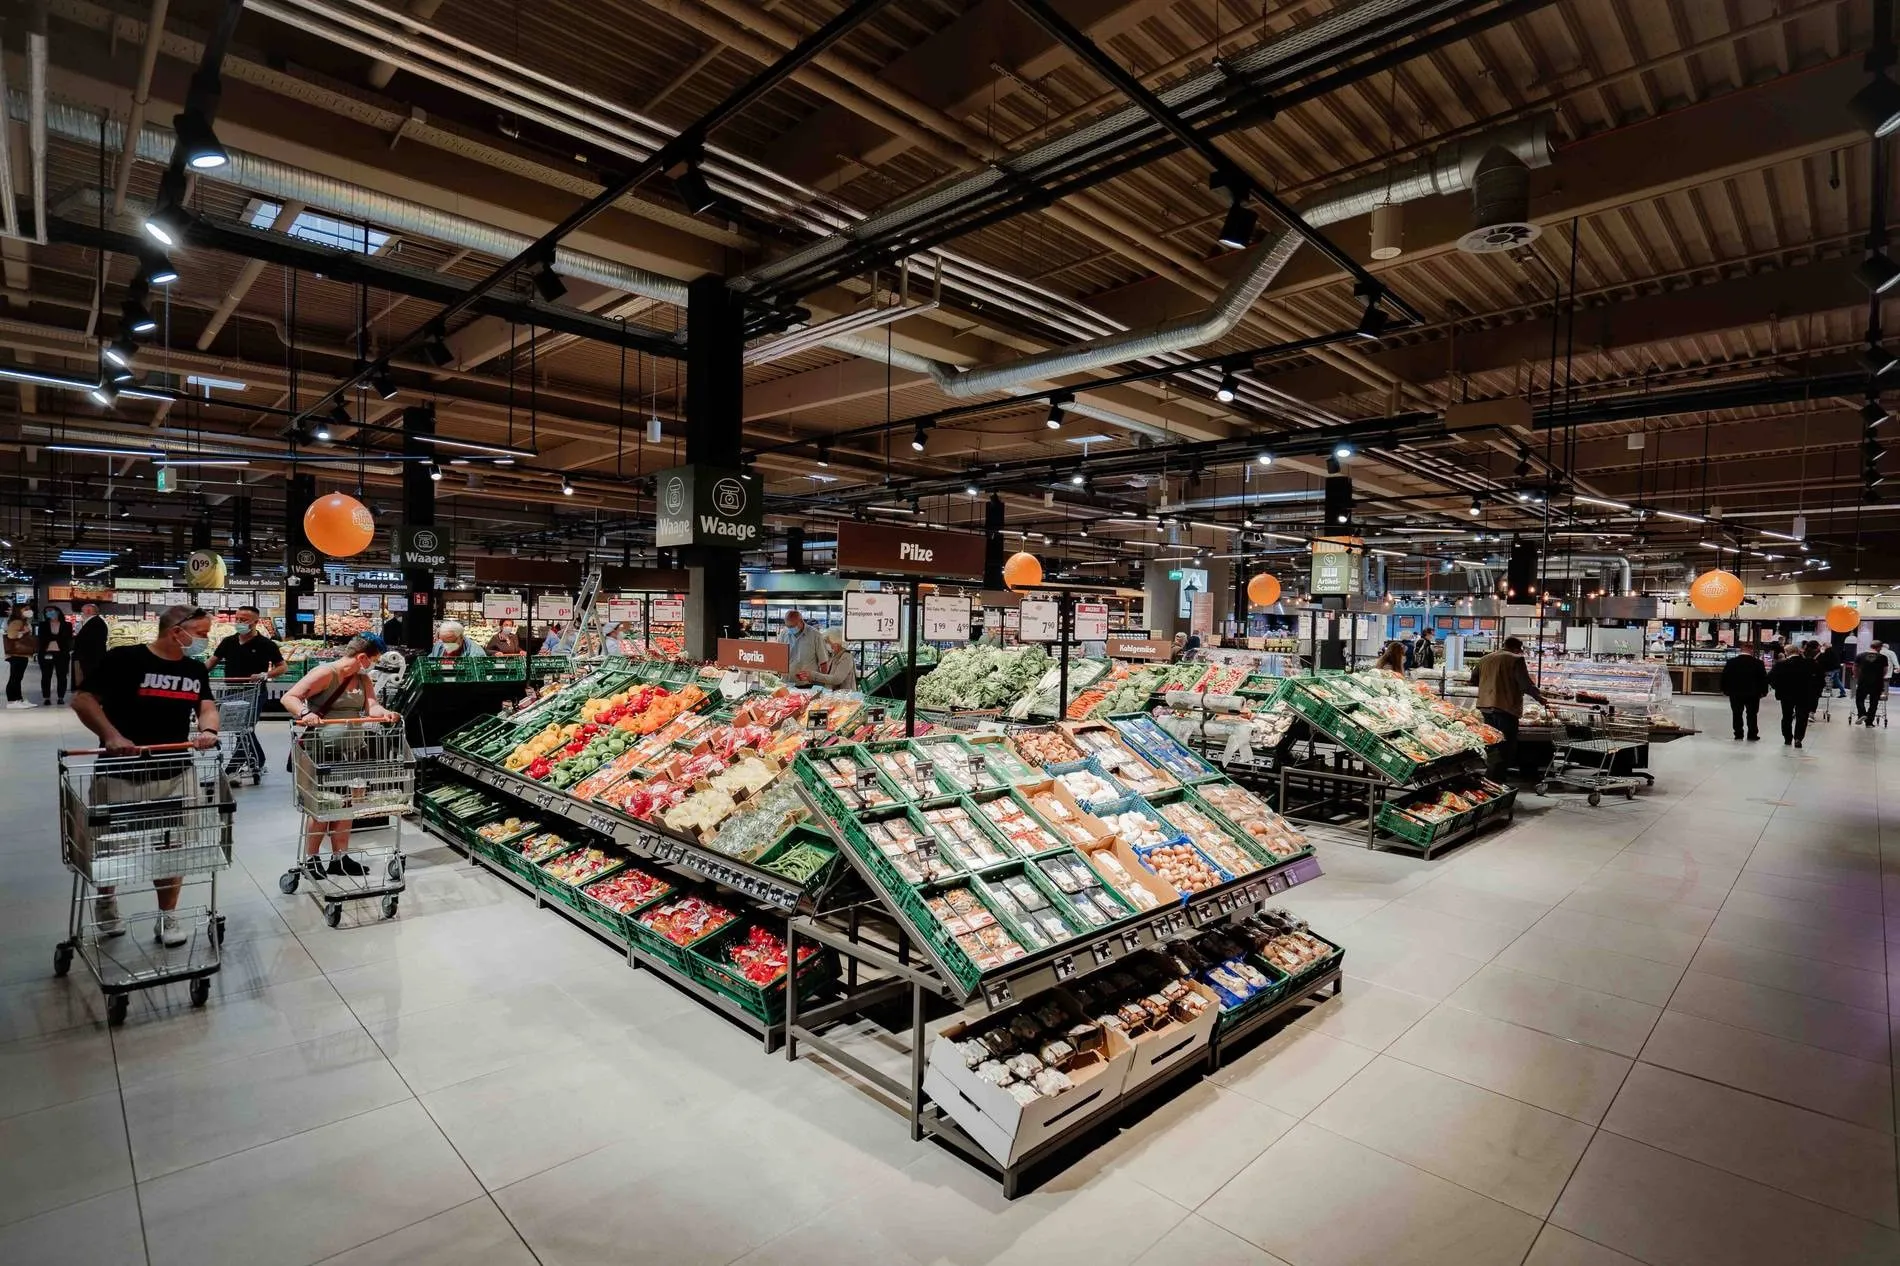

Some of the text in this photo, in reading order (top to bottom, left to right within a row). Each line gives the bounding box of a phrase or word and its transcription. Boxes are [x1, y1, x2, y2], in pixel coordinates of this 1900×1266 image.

[659, 518, 690, 536] Waage
[700, 515, 756, 541] Waage
[405, 552, 446, 565] Waage
[900, 542, 933, 562] Pilze
[291, 565, 321, 575] Waage
[738, 649, 765, 663] Paprika
[1119, 644, 1156, 654] Kohlgemüse
[140, 673, 201, 694] JUST DO
